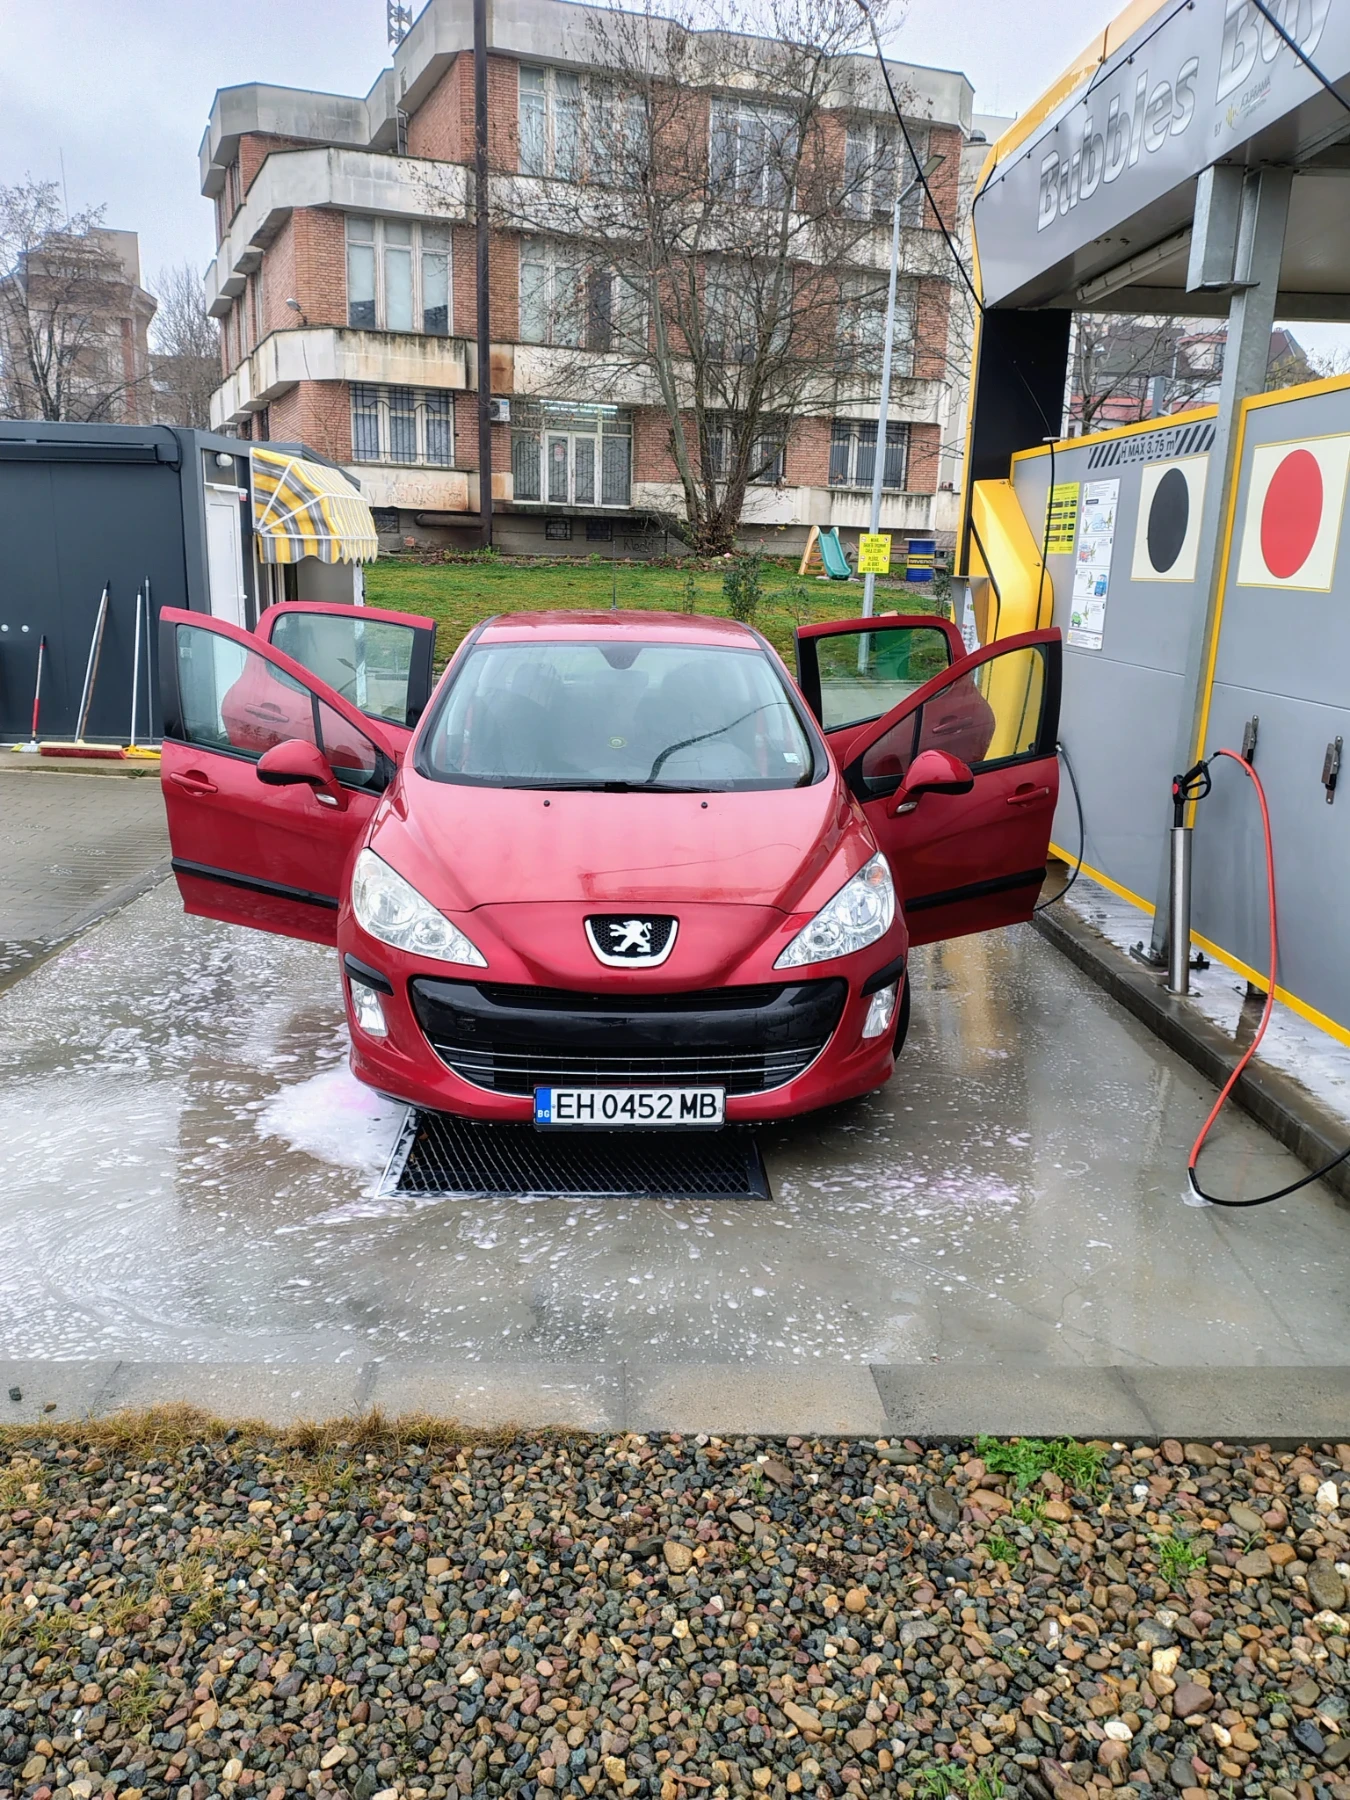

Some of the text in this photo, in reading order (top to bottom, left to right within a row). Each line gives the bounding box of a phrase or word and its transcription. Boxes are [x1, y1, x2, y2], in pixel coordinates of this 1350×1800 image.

[1037, 56, 1200, 233] Bubbles
[1121, 439, 1175, 458] H MAX 3.75 m
[537, 1110, 550, 1118] BG
[556, 1093, 717, 1119] EH 0452 MB
